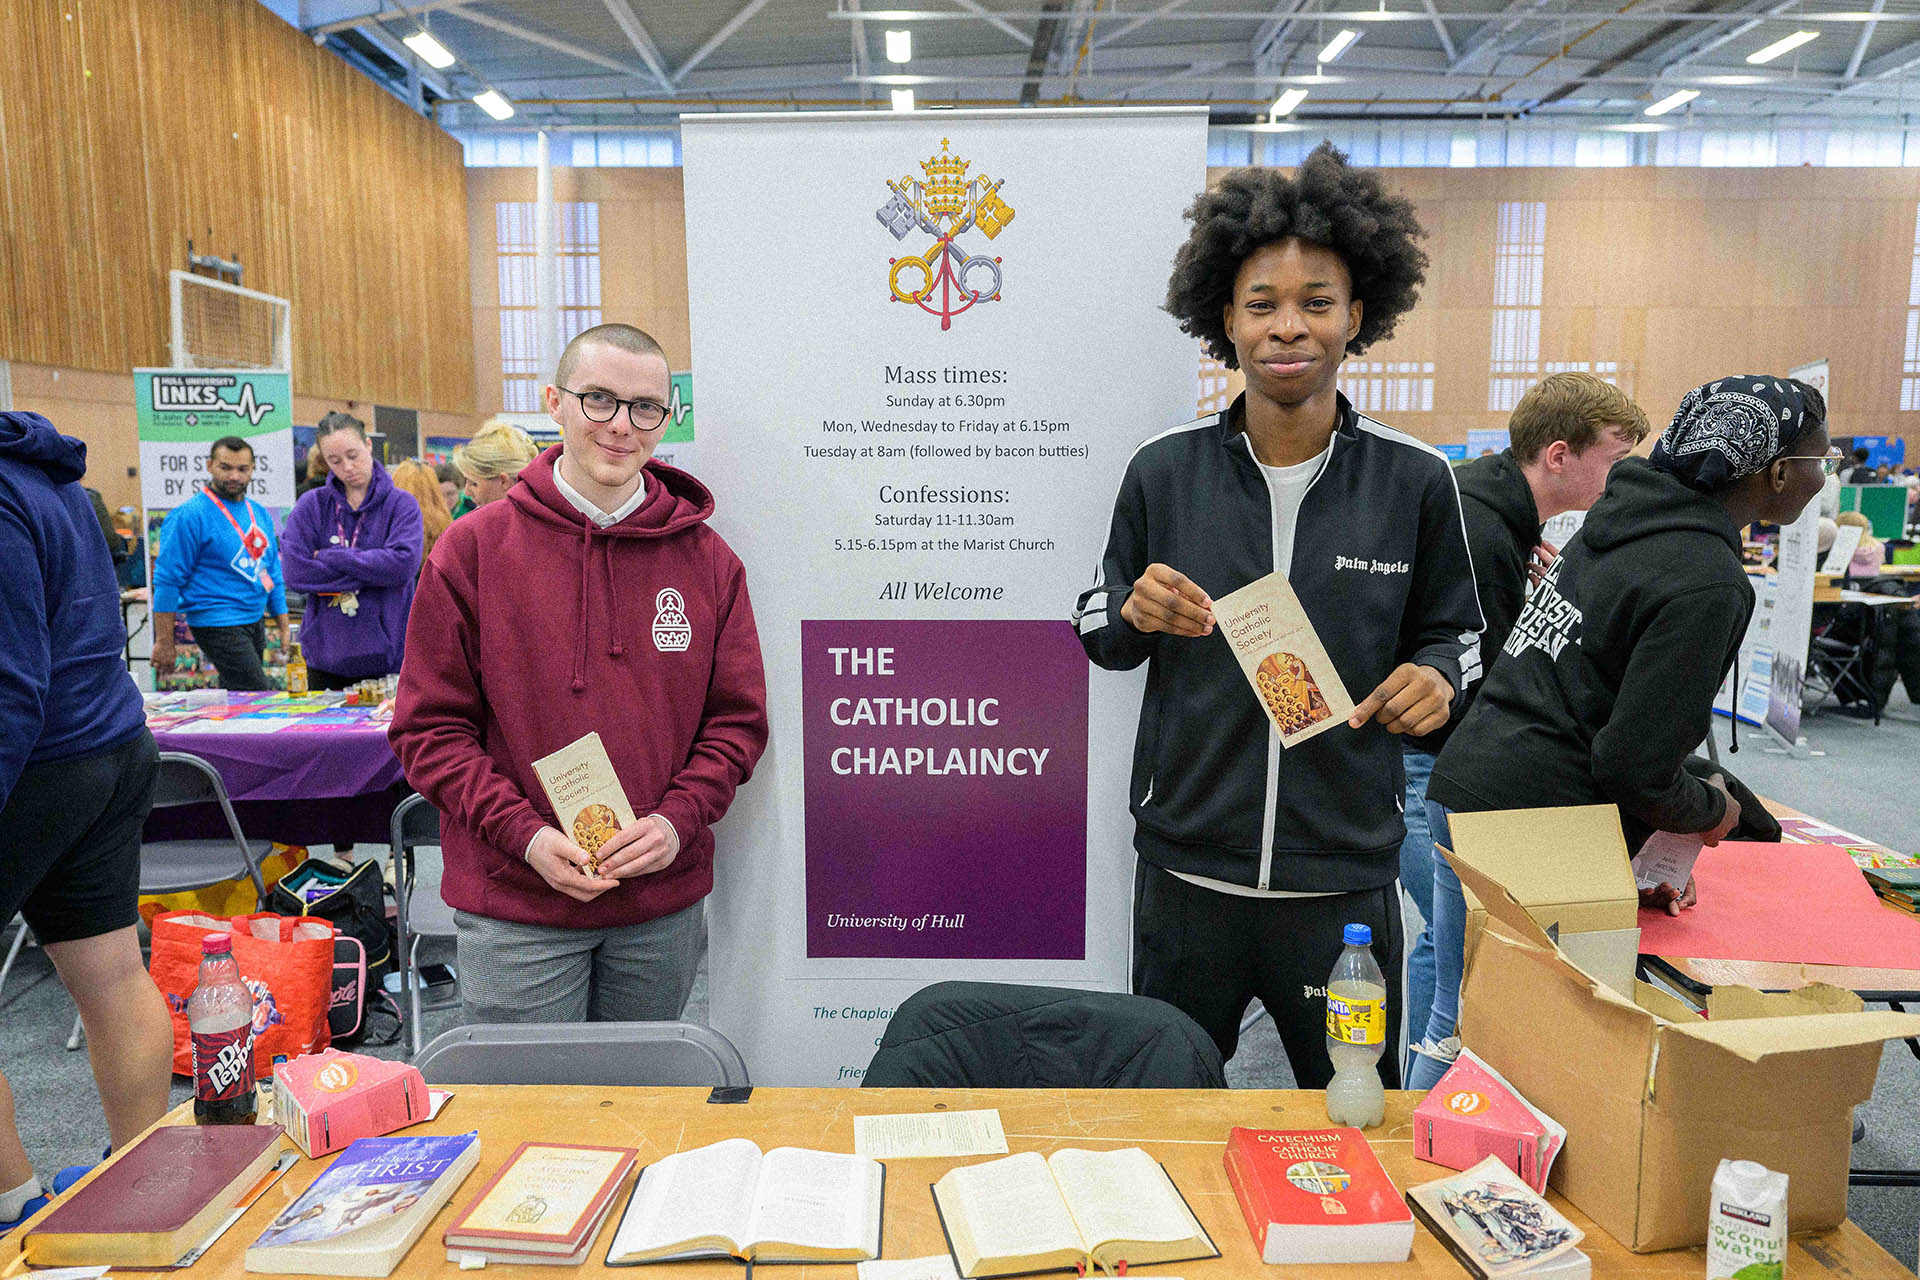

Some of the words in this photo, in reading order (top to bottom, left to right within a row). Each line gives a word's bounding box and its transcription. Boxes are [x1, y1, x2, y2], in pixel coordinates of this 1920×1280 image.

[884, 365, 936, 384] Mass
[943, 365, 1008, 384] times:
[886, 395, 935, 409] Sunday
[938, 396, 951, 407] at
[954, 395, 1006, 409] 6.30pm
[822, 420, 857, 434] Mon,
[861, 420, 938, 434] Wednesday
[941, 422, 955, 432] to
[959, 420, 999, 434] Friday
[1003, 422, 1016, 432] at
[1019, 420, 1070, 434] 6.15pm
[804, 445, 856, 460] Tuesday
[860, 447, 873, 457] at
[877, 445, 906, 457] 8am
[910, 445, 971, 459] (followed
[975, 445, 991, 460] by
[995, 445, 1035, 457] bacon
[1039, 445, 1089, 459] butties)
[161, 456, 188, 471] FOR
[165, 479, 184, 495] BY
[879, 485, 1009, 503] Confessions:
[874, 514, 932, 528] Saturday
[936, 514, 1015, 526] 11-11.30am
[834, 539, 917, 552] 5.15-6.15pm
[921, 540, 934, 550] at
[937, 539, 959, 551] the
[963, 539, 1005, 551] Marist
[1009, 539, 1055, 551] Church
[1335, 555, 1368, 571] Palm
[1369, 559, 1409, 575] Angels
[879, 582, 906, 600] All
[914, 582, 1004, 600] Welcome
[1224, 602, 1270, 628] University
[1230, 615, 1272, 639] Catholic
[1236, 628, 1272, 650] Society
[827, 647, 895, 675] THE
[830, 698, 999, 726] CATHOLIC
[830, 748, 1050, 776] CHAPLAINCY
[548, 760, 589, 785] University
[553, 771, 590, 794] Catholic
[558, 784, 590, 804] Society
[827, 914, 908, 930] University
[911, 914, 930, 930] of
[930, 914, 965, 928] Hull
[1303, 985, 1328, 998] Pal
[813, 1007, 837, 1019] The
[217, 1039, 241, 1070] Dr
[1257, 1134, 1341, 1143] CATECHISM
[1272, 1145, 1338, 1153] CATHOLIC
[1279, 1152, 1337, 1160] CHURCH
[331, 1157, 452, 1178] CHRIST
[1715, 1237, 1775, 1265] water
